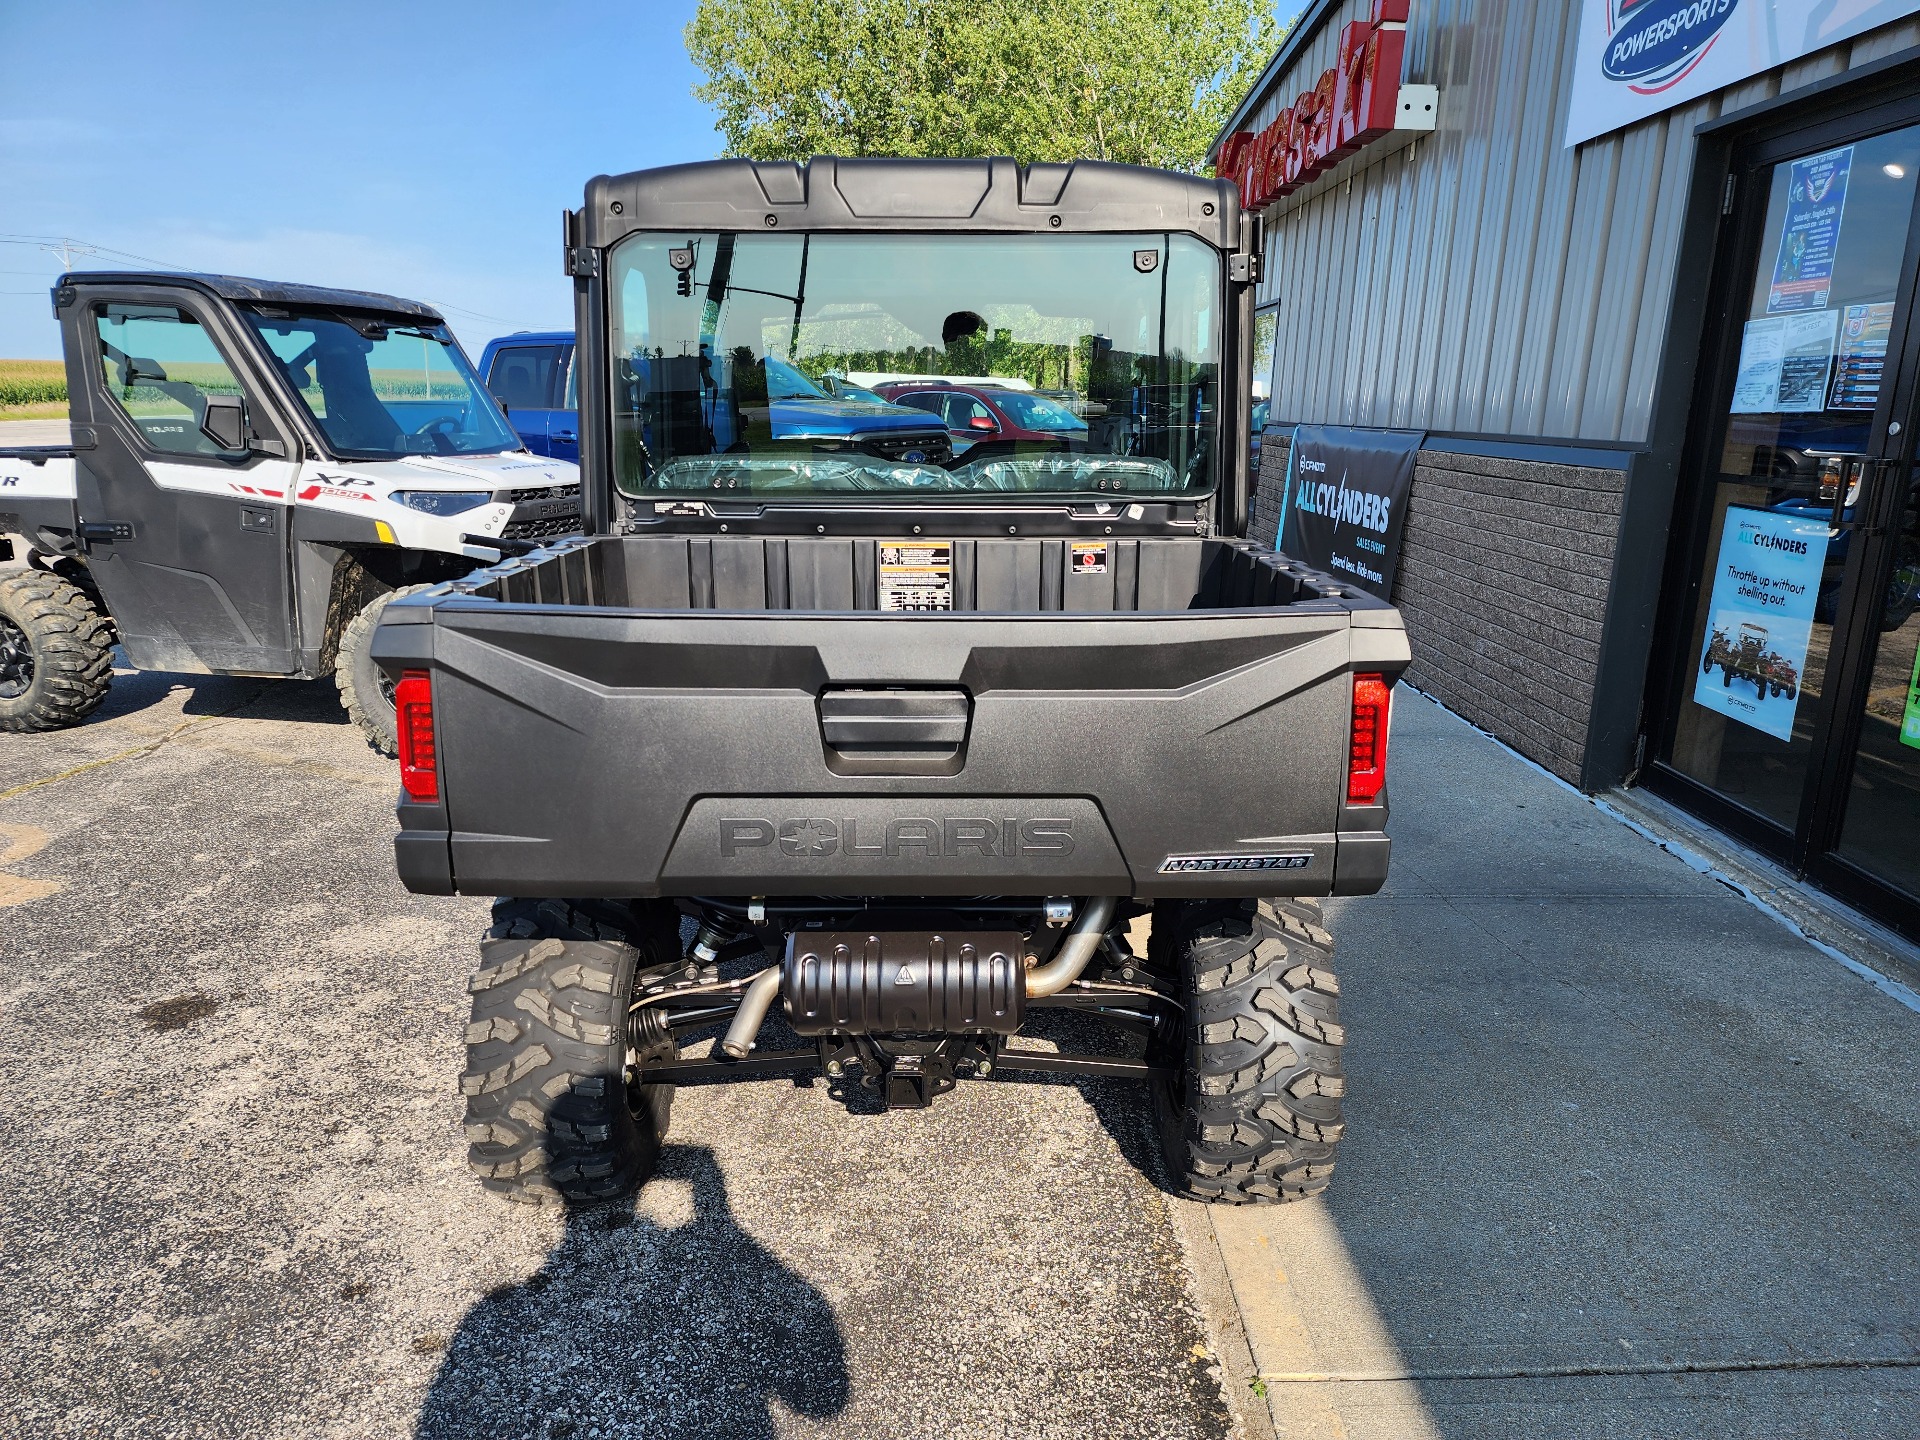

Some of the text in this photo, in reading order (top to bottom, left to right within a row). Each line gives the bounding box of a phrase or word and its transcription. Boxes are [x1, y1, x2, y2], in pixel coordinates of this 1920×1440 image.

[304, 472, 376, 487] XP
[541, 502, 580, 516] POLARI
[1356, 536, 1386, 556] SALES EVENT
[1330, 551, 1346, 570] Spend
[1356, 560, 1367, 578] Ride
[1727, 565, 1806, 596] Throttle up without
[1737, 583, 1786, 607] shelling out.
[1734, 699, 1756, 711] CFMOTO
[719, 816, 1076, 858] POLARIS
[1168, 857, 1307, 871] NORTHSTAR
